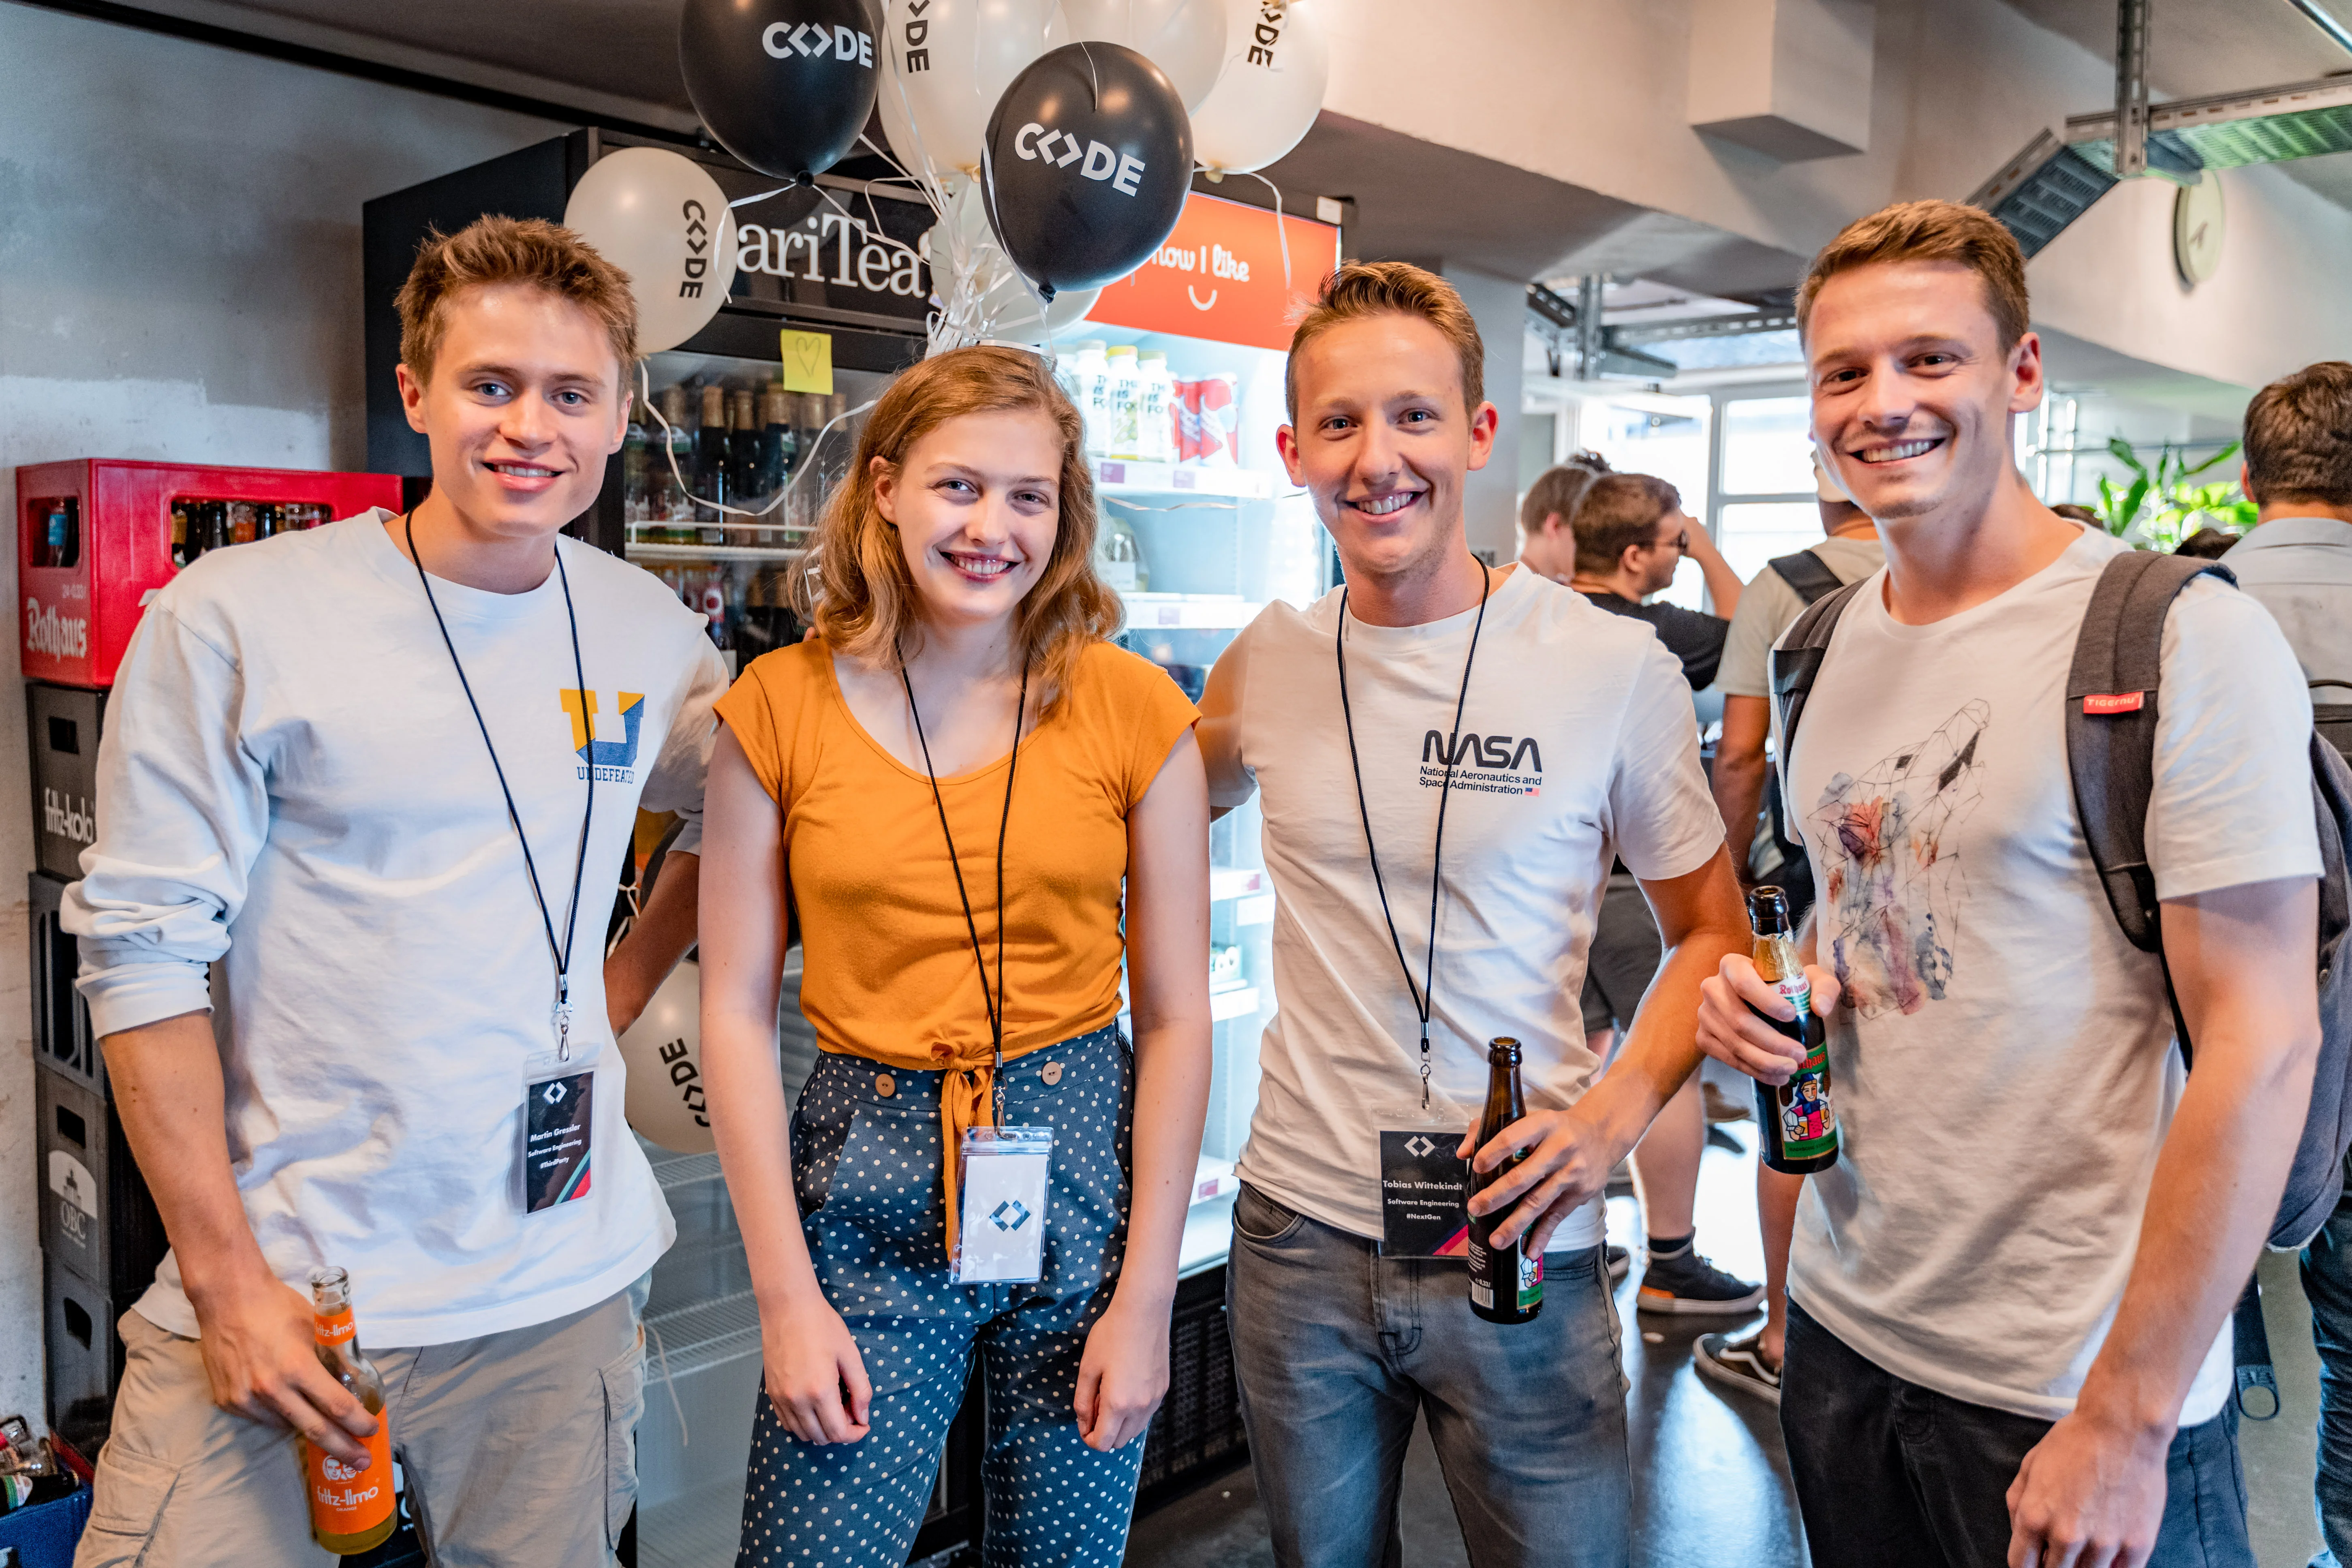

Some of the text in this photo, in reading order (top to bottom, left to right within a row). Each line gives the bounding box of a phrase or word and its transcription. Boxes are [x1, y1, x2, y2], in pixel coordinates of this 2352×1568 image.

[1200, 245, 1206, 274] I
[1212, 244, 1250, 282] like
[27, 597, 87, 663] Rothaus
[1422, 729, 1542, 772] NASA
[1460, 770, 1520, 783] Aeronautics
[1522, 777, 1542, 785] and
[1450, 780, 1523, 795] Administration
[530, 1123, 581, 1142] Martin Gressler
[528, 1139, 582, 1157] Software Engineering
[1383, 1180, 1463, 1190] Tobias Wittekindt
[1420, 1200, 1459, 1208] Engineering
[317, 1485, 378, 1506] fritz-limo
